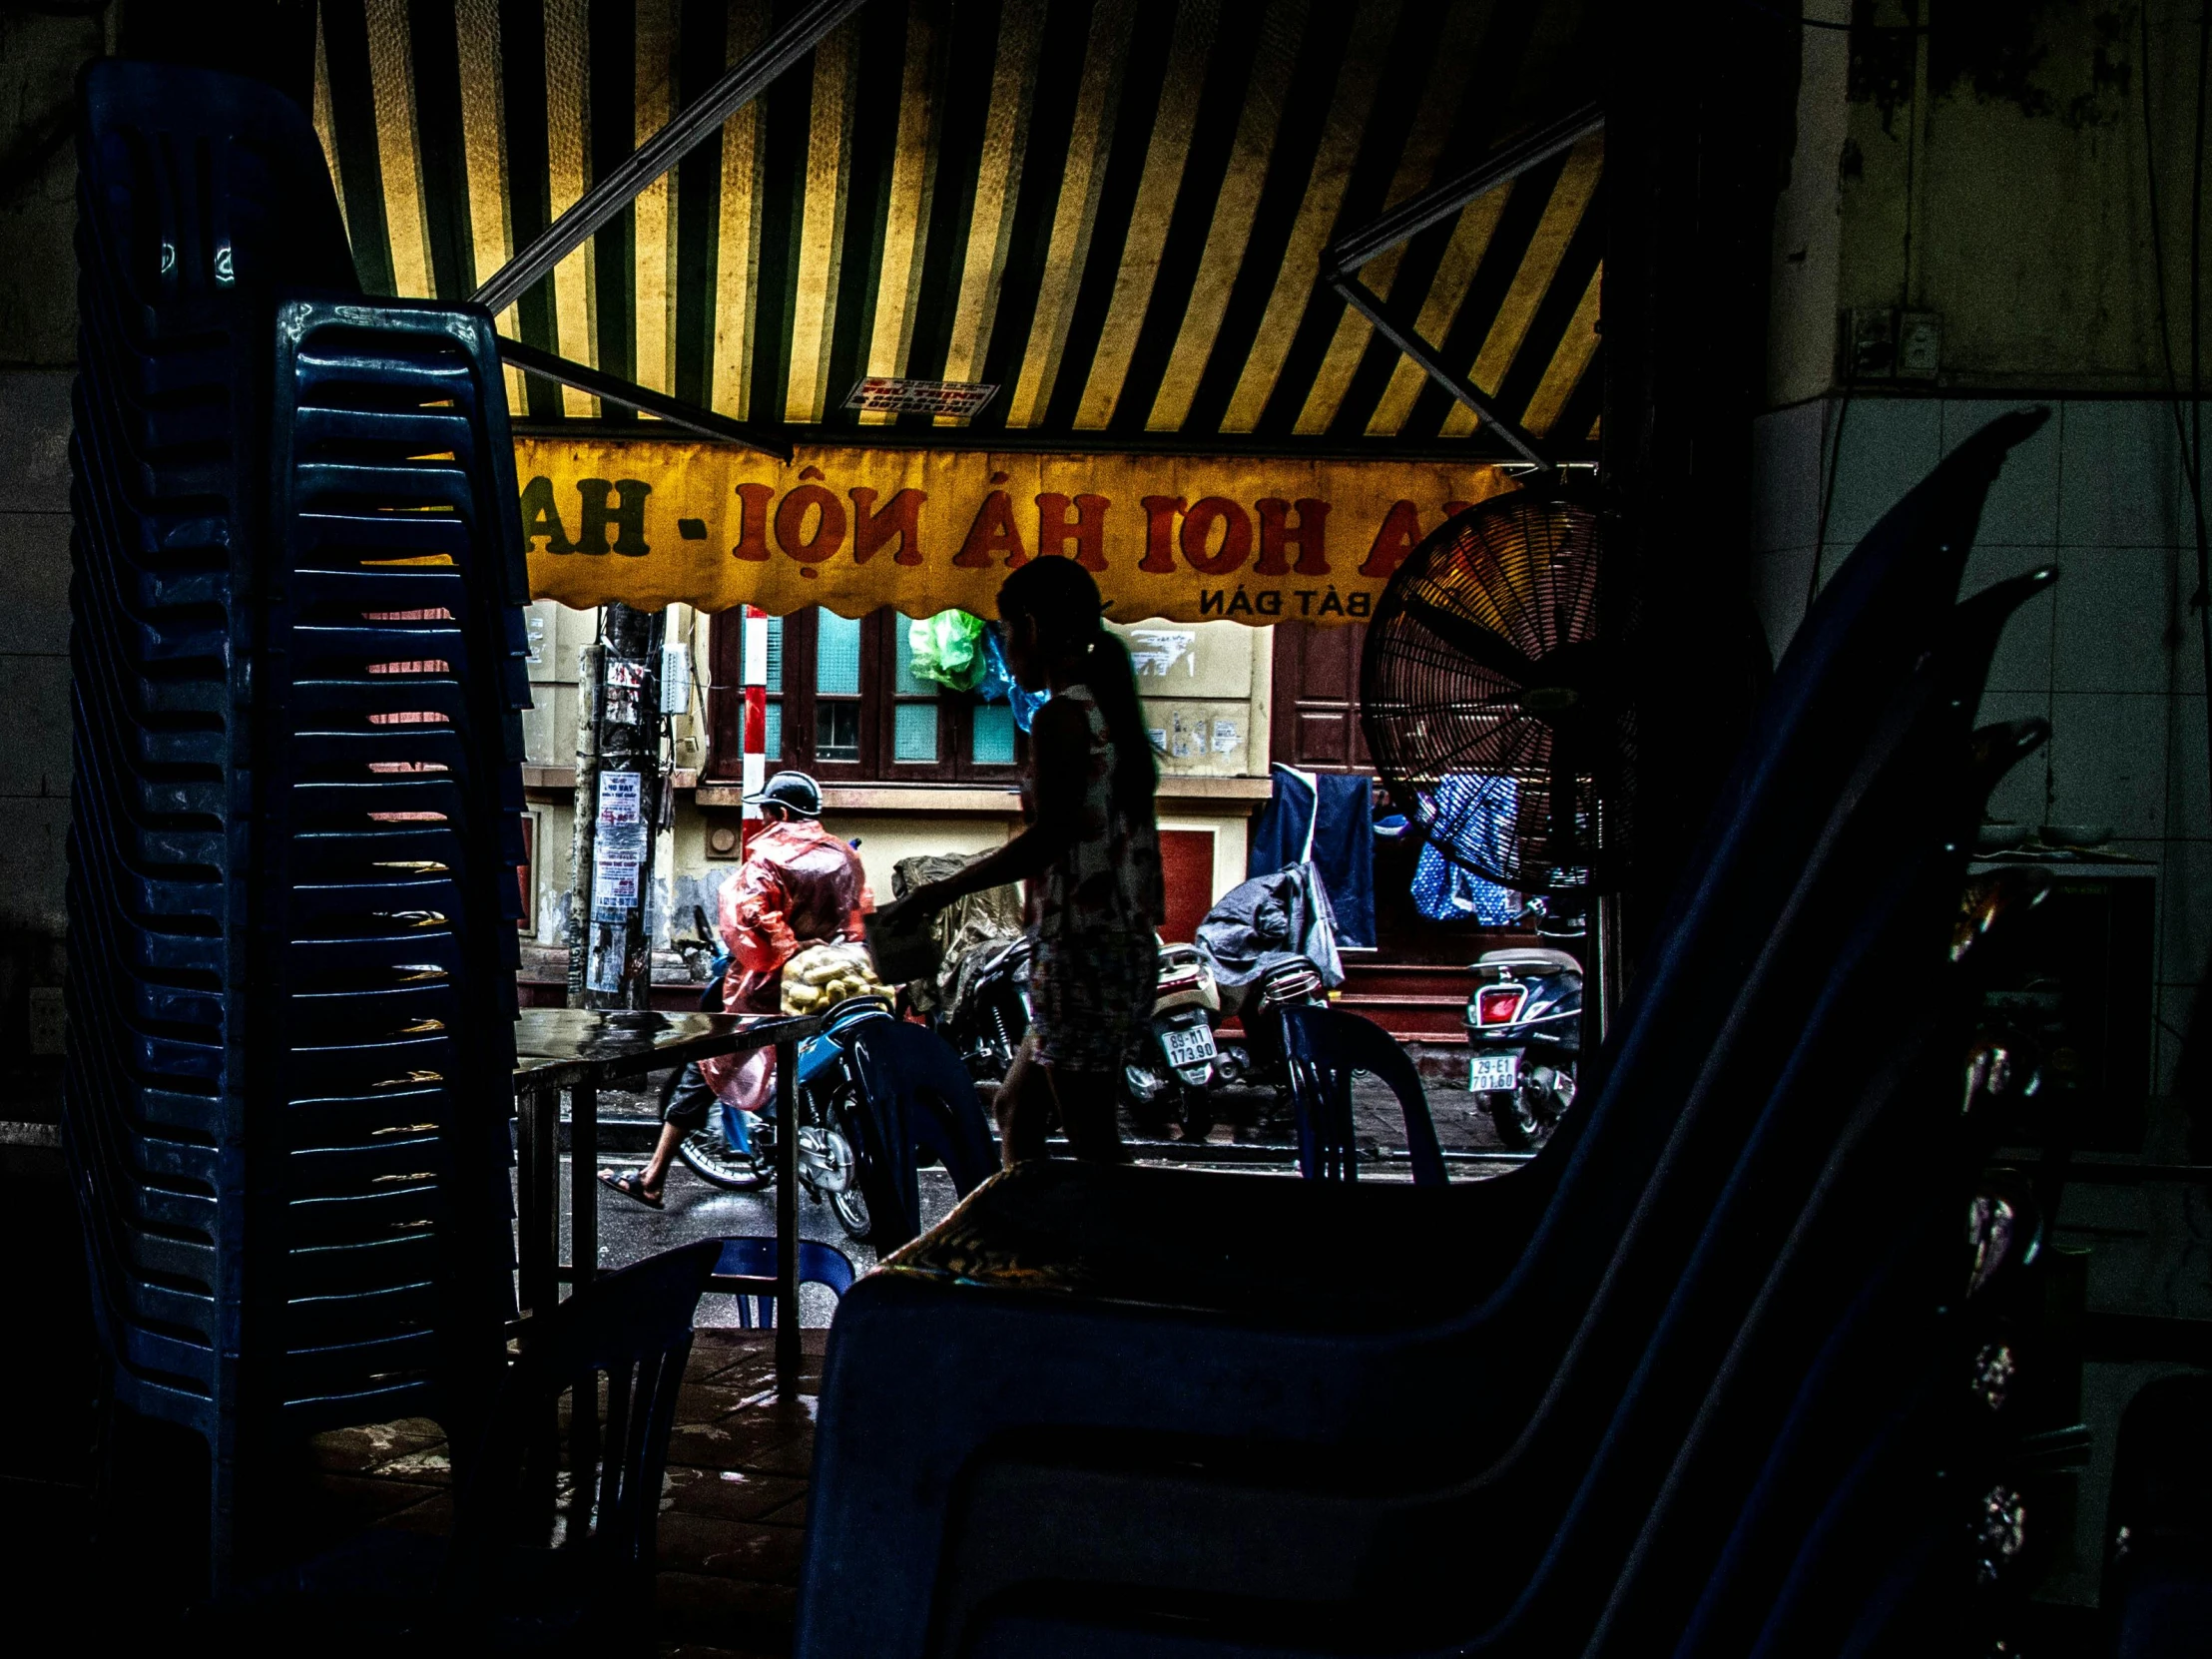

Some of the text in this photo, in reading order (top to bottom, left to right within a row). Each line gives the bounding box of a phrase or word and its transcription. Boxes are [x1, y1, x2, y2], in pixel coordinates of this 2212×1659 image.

[1170, 1029, 1204, 1048] 89-M1
[1170, 1042, 1214, 1064] 173.90
[1477, 1059, 1509, 1074] 29-E1
[1473, 1073, 1513, 1089] 701.60
